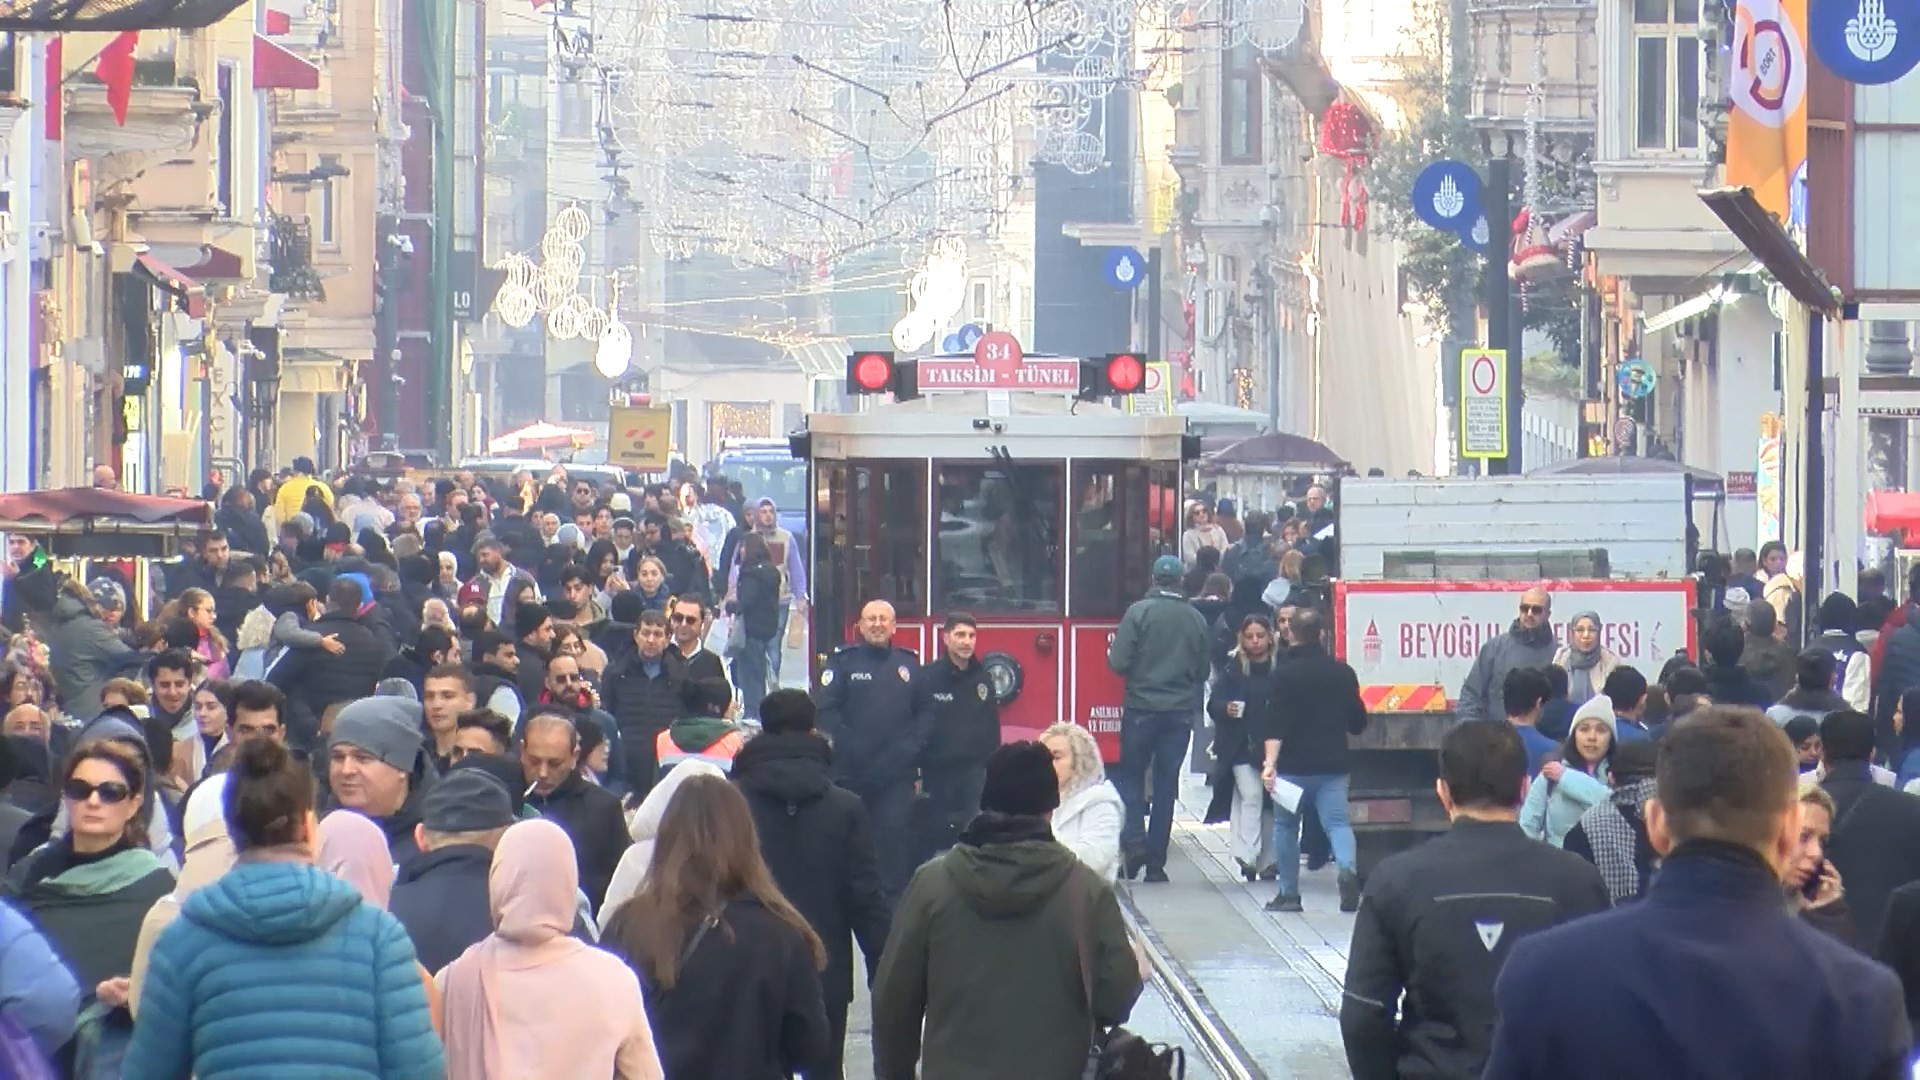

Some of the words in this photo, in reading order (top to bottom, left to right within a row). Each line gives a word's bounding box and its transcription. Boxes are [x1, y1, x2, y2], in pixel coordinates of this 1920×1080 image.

[986, 343, 1012, 361] 34
[926, 365, 996, 383] TAKSİM
[1015, 365, 1074, 384] TÜNEL
